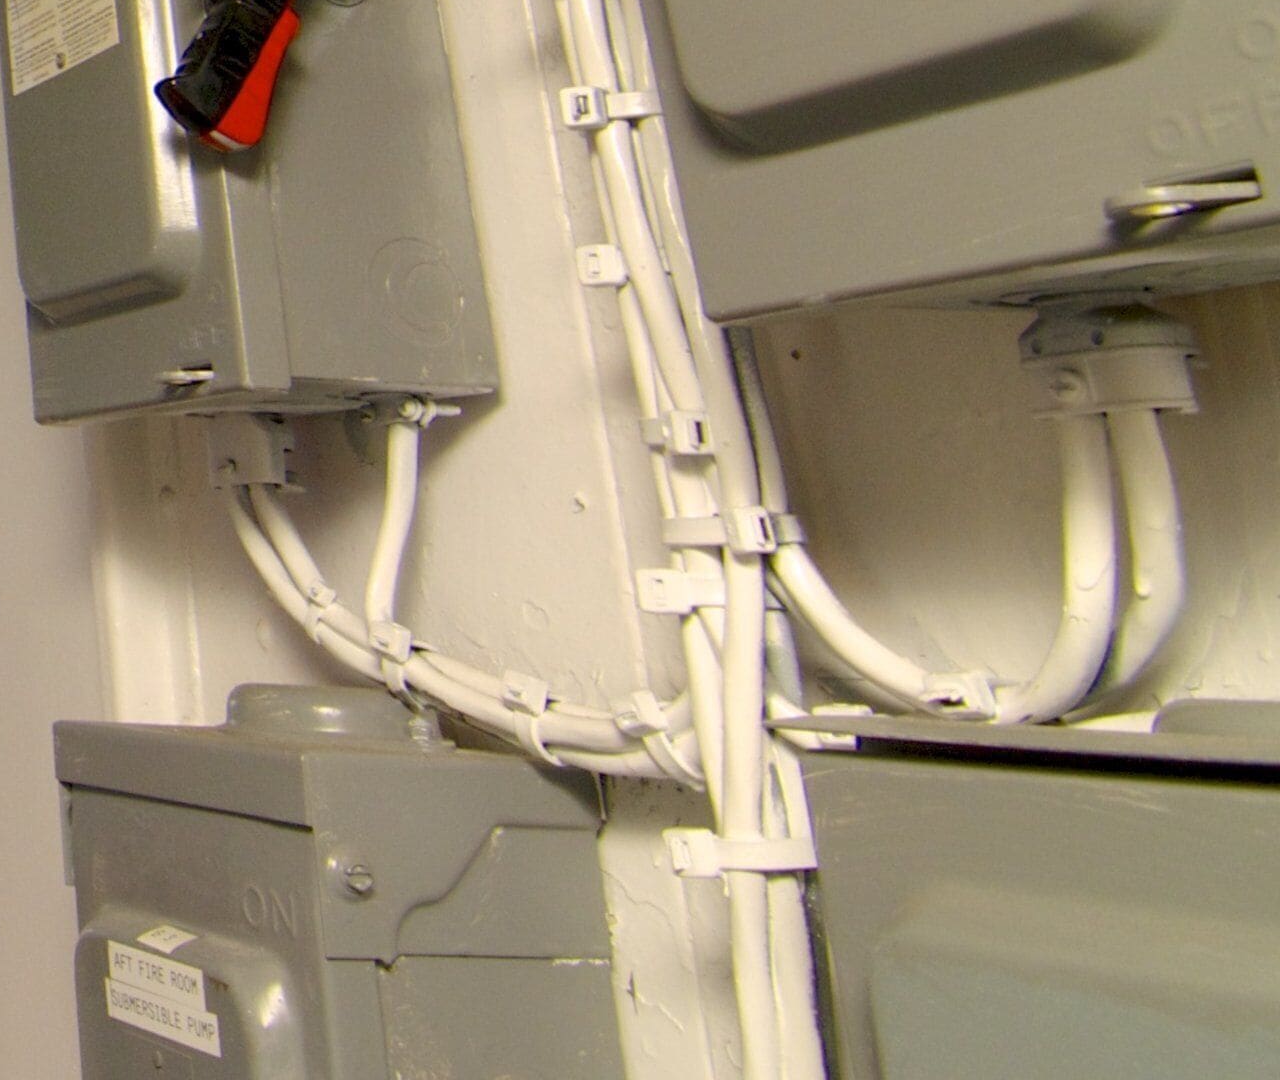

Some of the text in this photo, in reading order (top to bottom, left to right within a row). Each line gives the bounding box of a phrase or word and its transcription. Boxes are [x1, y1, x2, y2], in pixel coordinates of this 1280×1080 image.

[243, 884, 298, 940] ON
[114, 952, 198, 995] AFT FIRE ROOM
[111, 988, 216, 1042] SUBMERSIBLE PUMP
